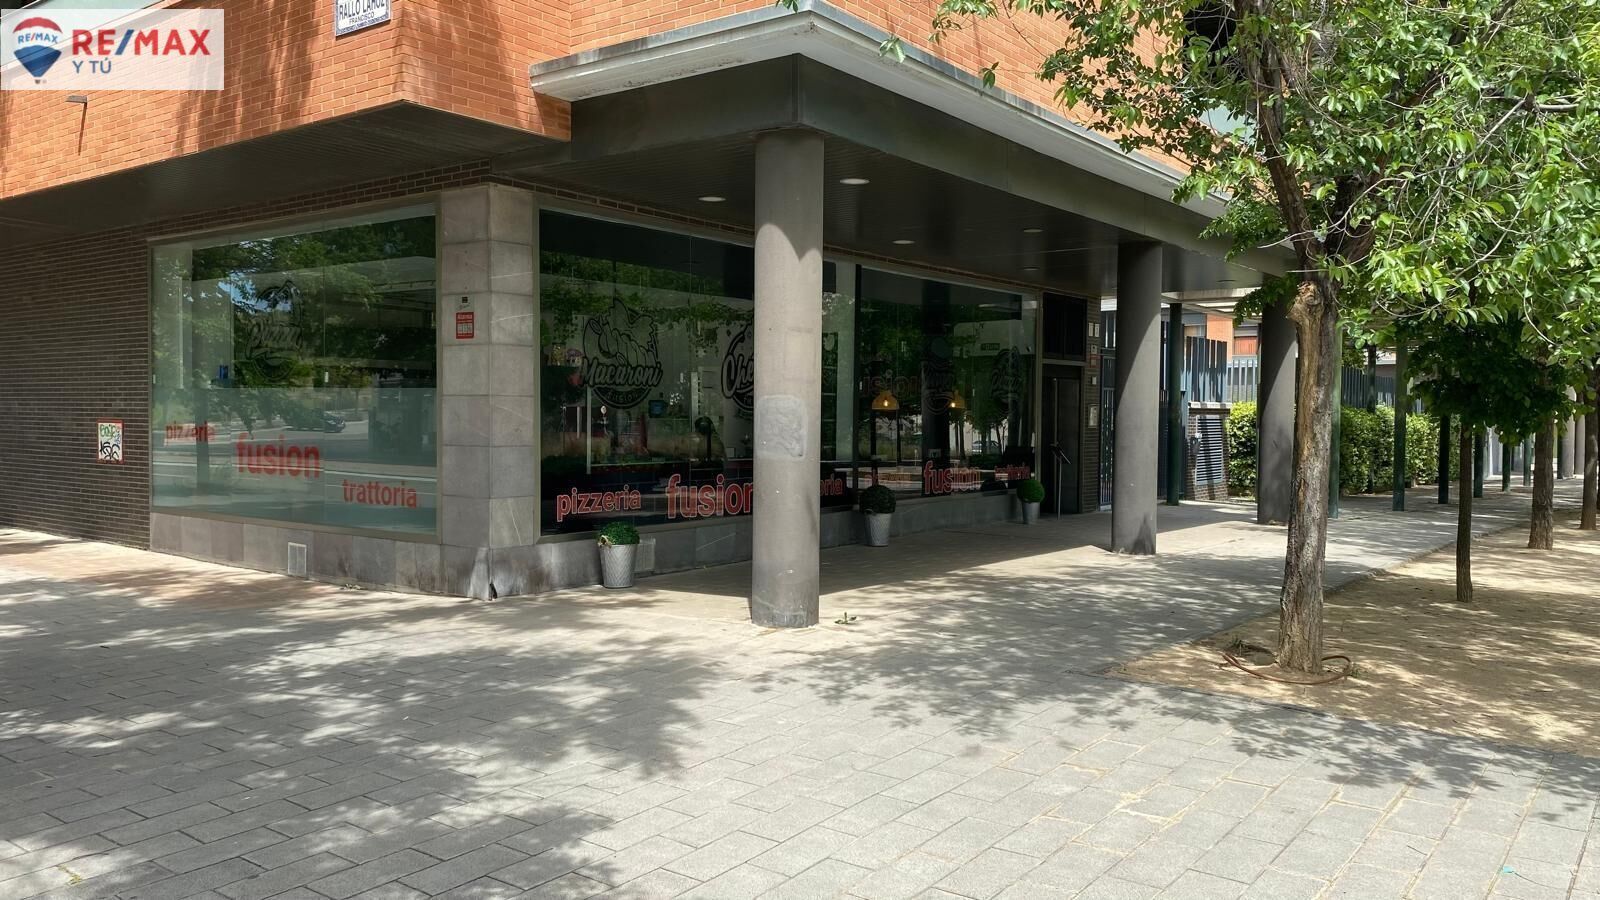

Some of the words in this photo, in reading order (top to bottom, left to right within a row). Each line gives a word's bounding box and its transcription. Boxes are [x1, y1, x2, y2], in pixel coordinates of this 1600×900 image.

[349, 11, 375, 24] FRANCISCO
[580, 356, 664, 388] Macaroni
[235, 432, 320, 479] fusion
[343, 479, 417, 508] trattoria
[924, 459, 981, 495] fusion
[556, 484, 642, 523] pizzeria
